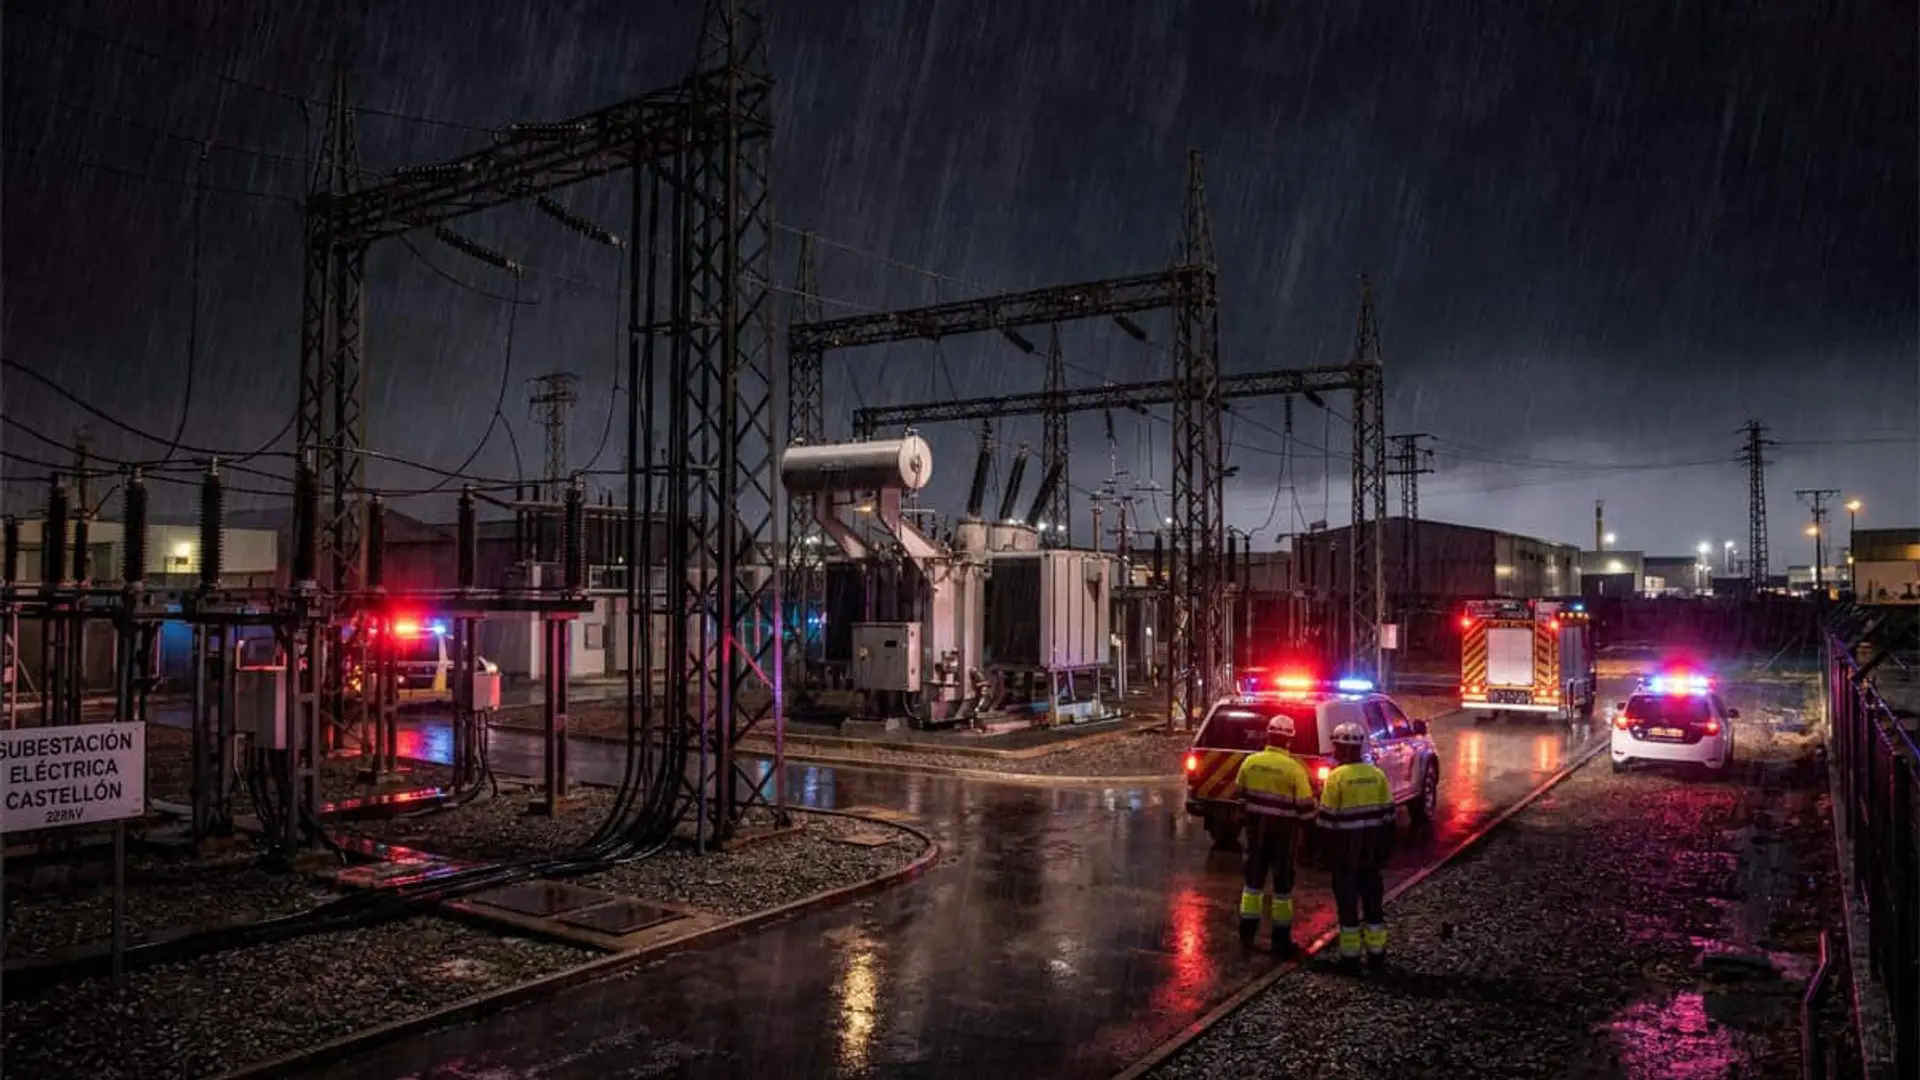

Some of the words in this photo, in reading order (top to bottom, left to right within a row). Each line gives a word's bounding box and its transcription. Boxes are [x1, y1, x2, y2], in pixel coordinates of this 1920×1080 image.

[0, 729, 132, 759] SUBESTACIÓN
[10, 758, 118, 784] ELÉCTRICA
[6, 780, 122, 810] CASTELLÓN
